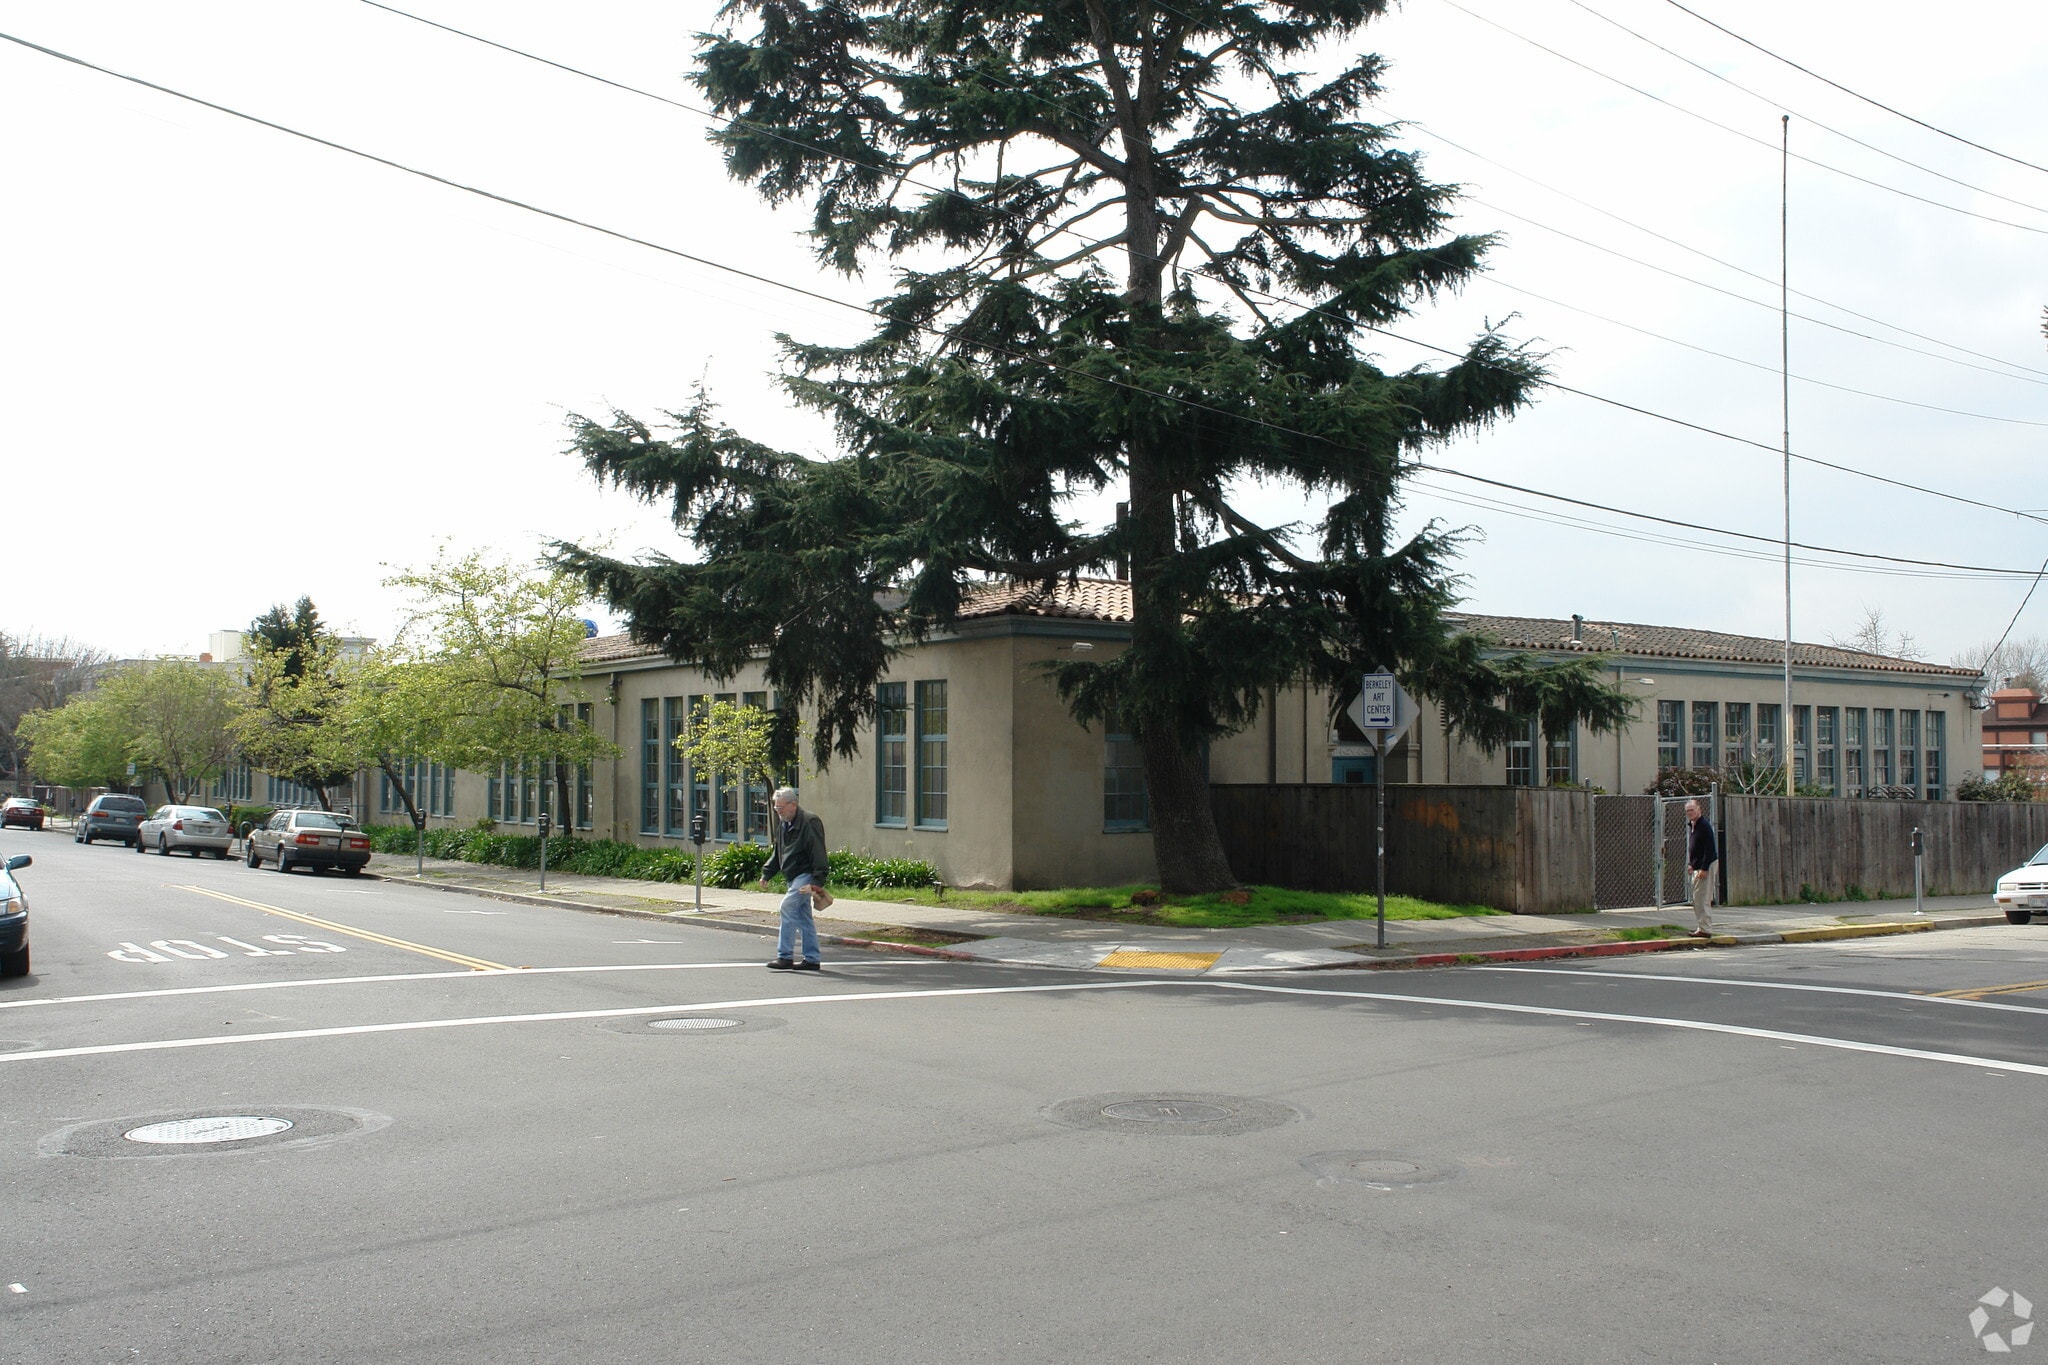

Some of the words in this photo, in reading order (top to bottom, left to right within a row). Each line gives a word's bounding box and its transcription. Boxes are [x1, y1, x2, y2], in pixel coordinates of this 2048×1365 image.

[1366, 680, 1391, 689] BERKELEY
[1373, 693, 1384, 701] ART
[1367, 705, 1391, 714] CENTER
[106, 934, 347, 963] STOP
